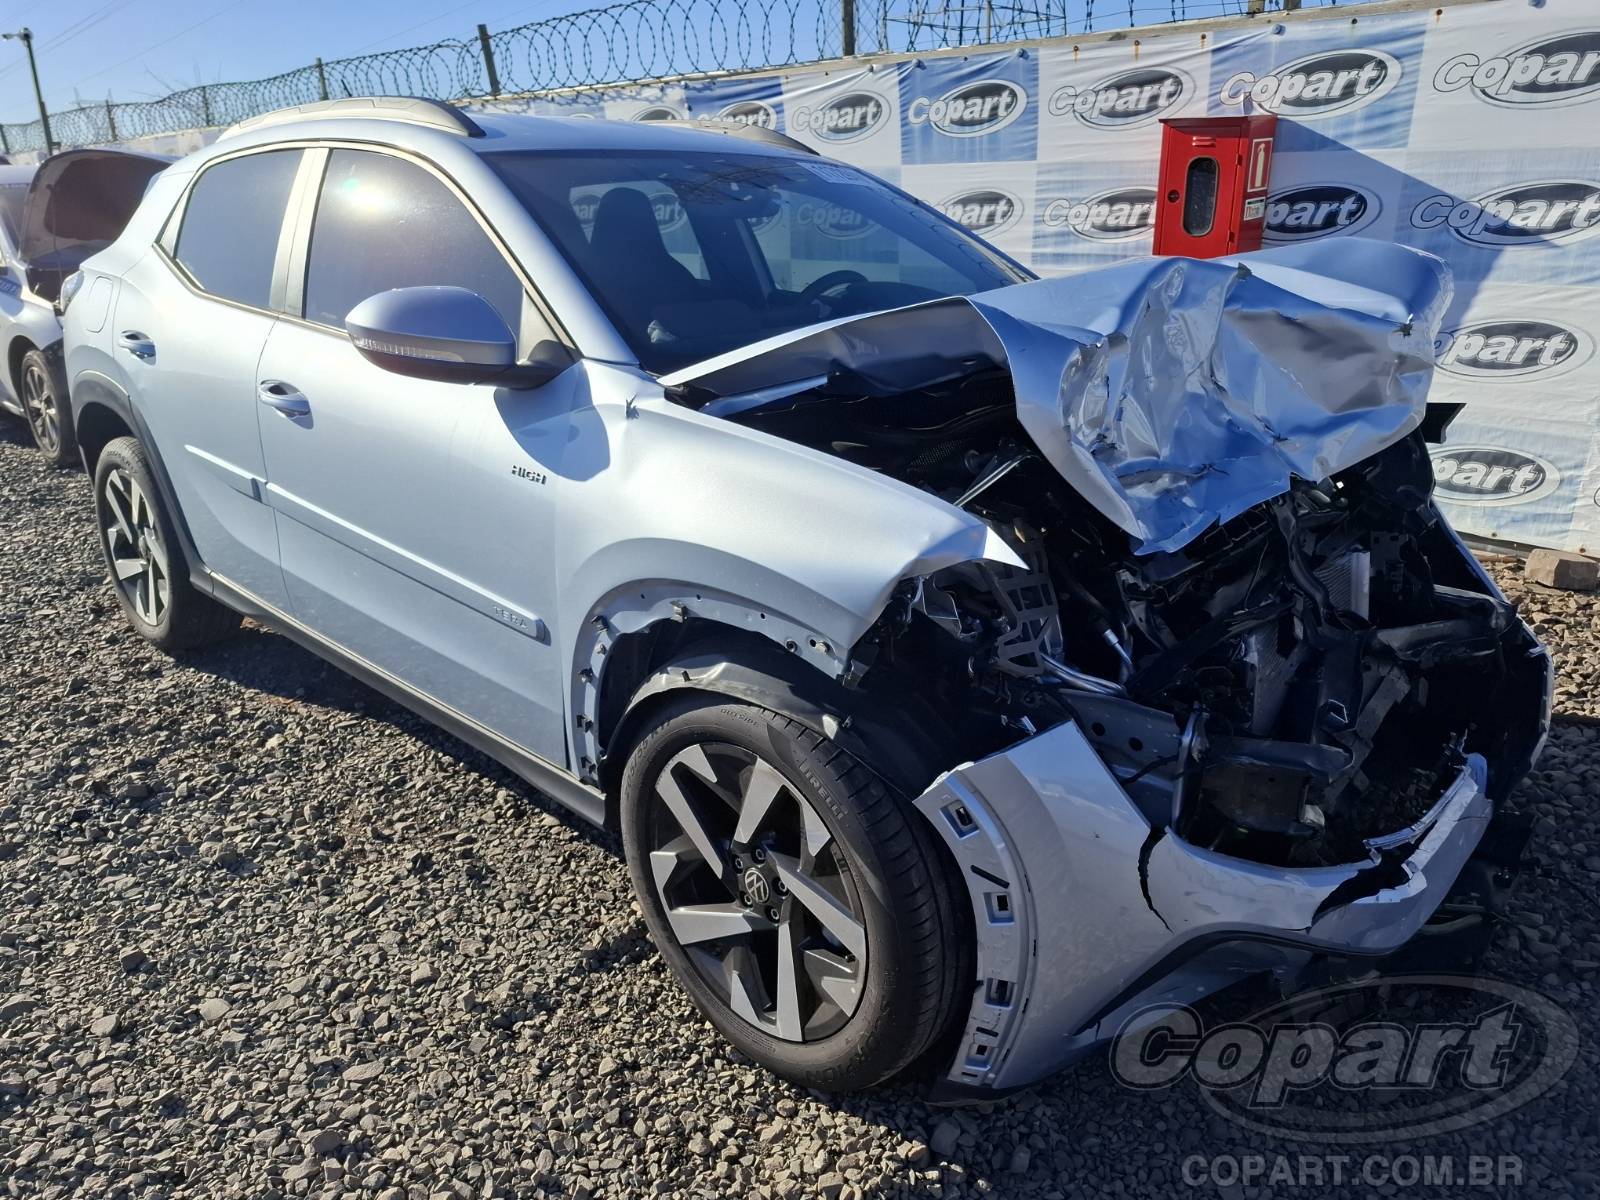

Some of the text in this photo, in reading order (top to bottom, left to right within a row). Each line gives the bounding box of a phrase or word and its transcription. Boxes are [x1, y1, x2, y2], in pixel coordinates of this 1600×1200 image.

[1048, 76, 1183, 120] Copart
[1219, 55, 1383, 110] Copart
[792, 100, 881, 132] Copart
[908, 89, 1018, 128] Copart
[943, 197, 1009, 226] part
[1265, 191, 1362, 228] part
[1410, 193, 1600, 236] Copart
[511, 464, 548, 485] HIGH
[1432, 457, 1540, 495] part
